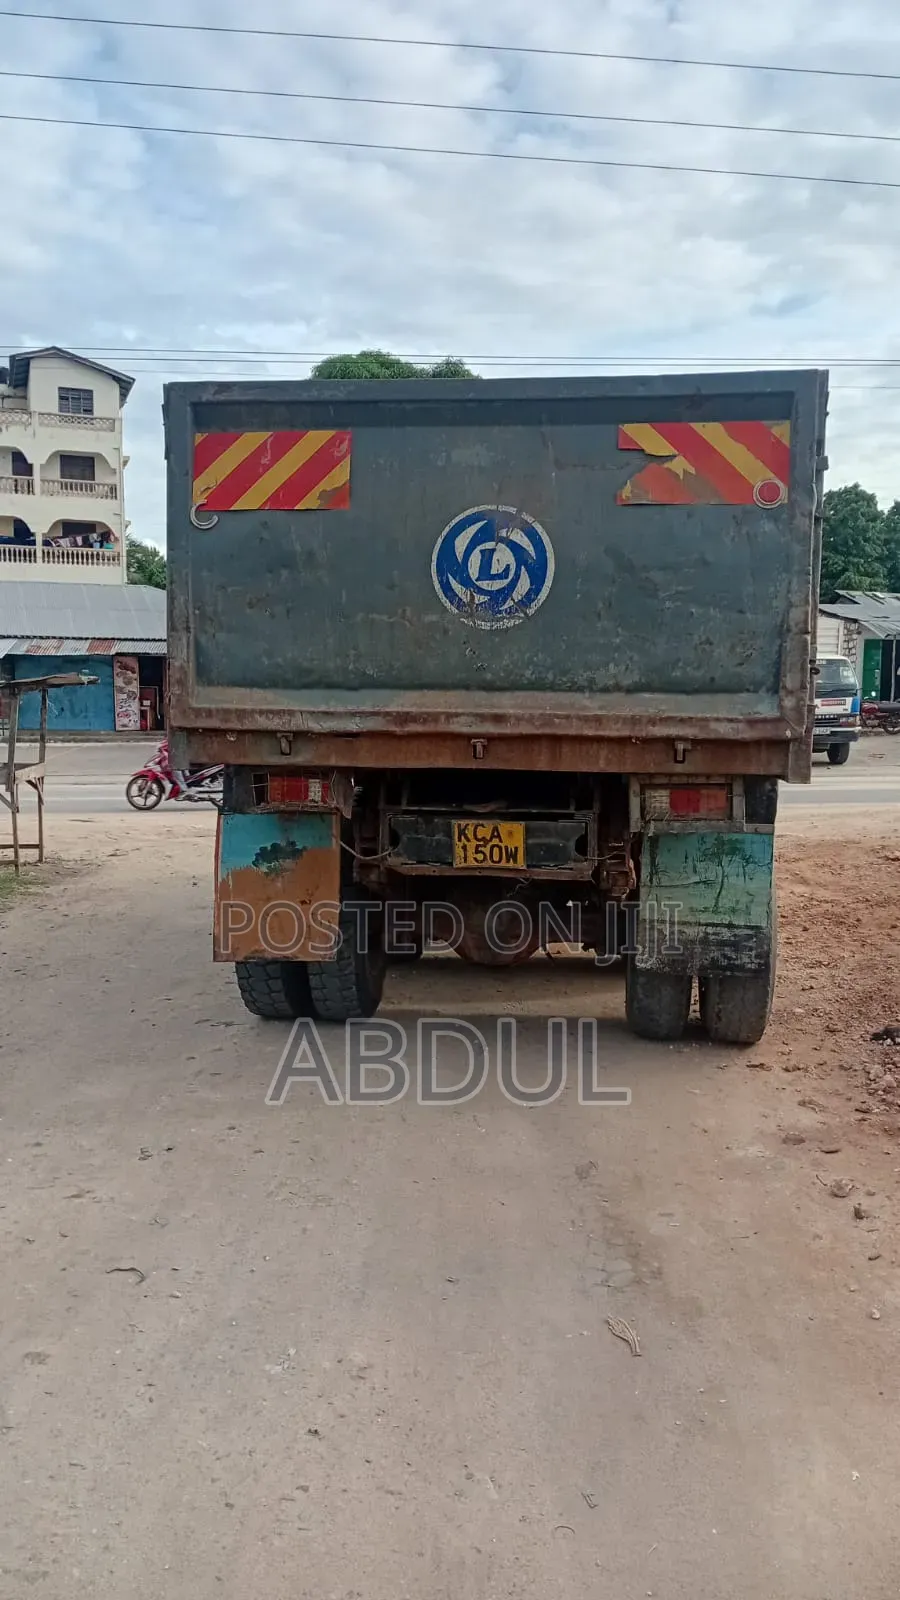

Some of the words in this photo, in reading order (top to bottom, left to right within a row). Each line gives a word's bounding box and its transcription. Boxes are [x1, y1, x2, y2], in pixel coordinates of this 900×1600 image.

[474, 547, 512, 582] L
[457, 823, 503, 844] KCA
[461, 842, 519, 865] 150W
